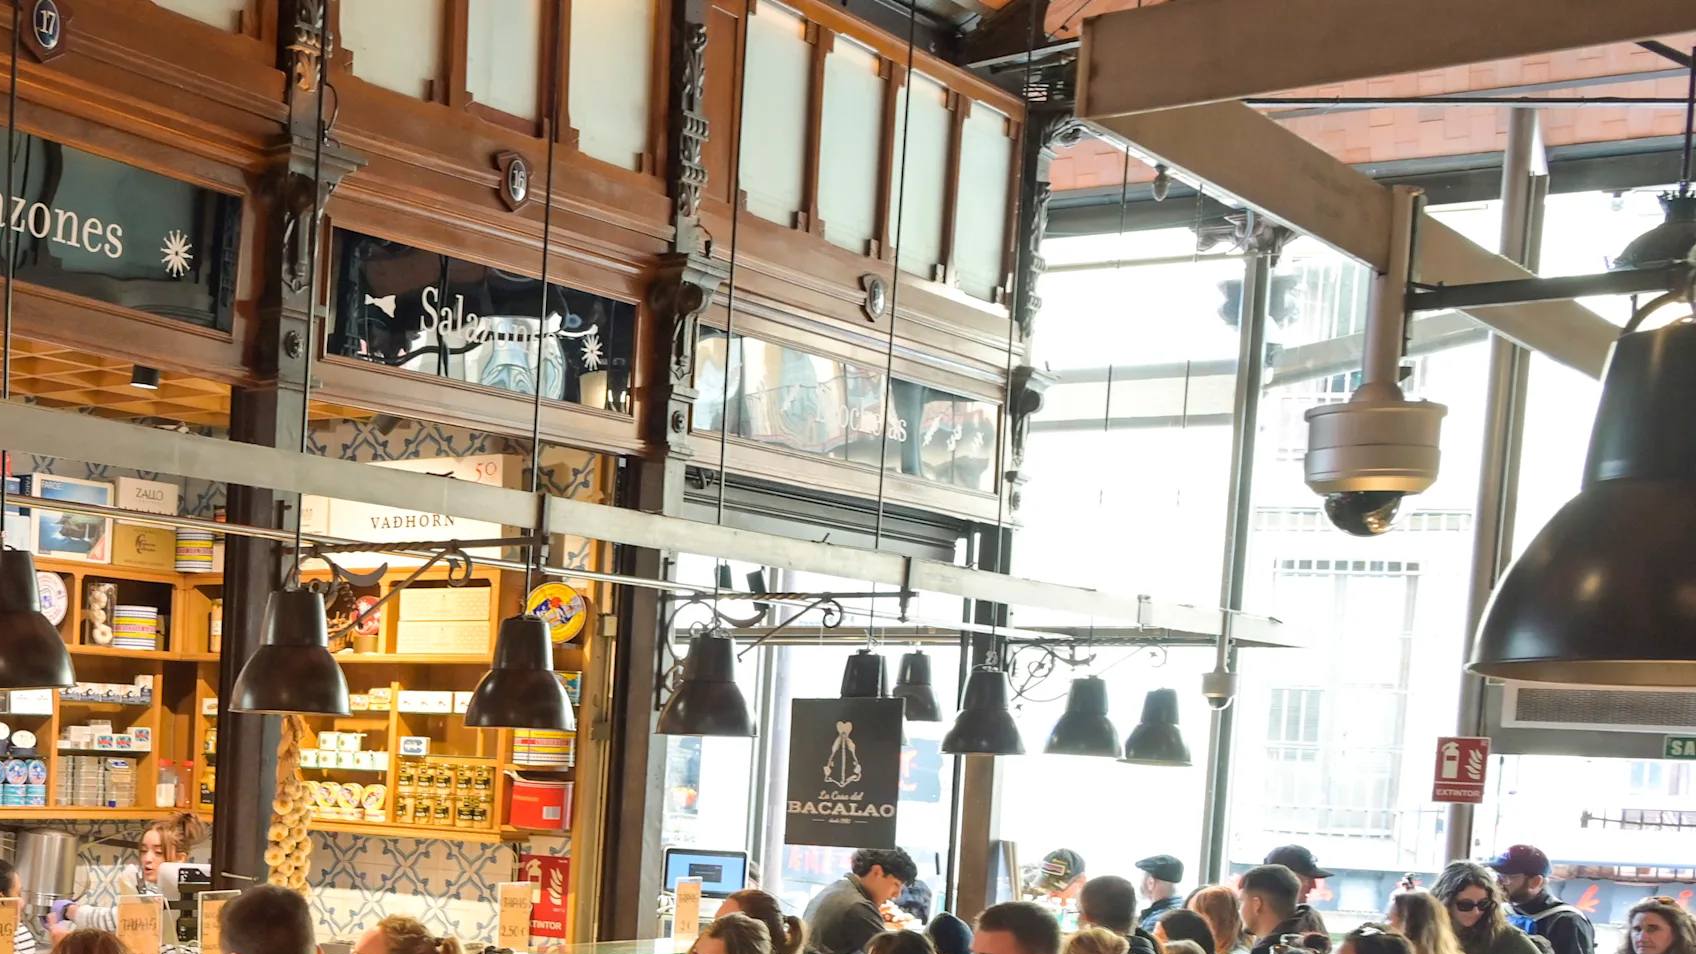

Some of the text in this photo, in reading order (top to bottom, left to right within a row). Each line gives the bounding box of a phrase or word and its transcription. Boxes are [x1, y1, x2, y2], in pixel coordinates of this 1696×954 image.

[40, 10, 56, 35] 17
[513, 169, 524, 190] 16
[475, 461, 497, 481] 50
[136, 487, 164, 501] ZALLO
[1671, 740, 1696, 756] SA
[1435, 788, 1481, 797] EXTINTOR
[788, 801, 895, 817] BACALAO
[121, 918, 157, 932] TAPAS
